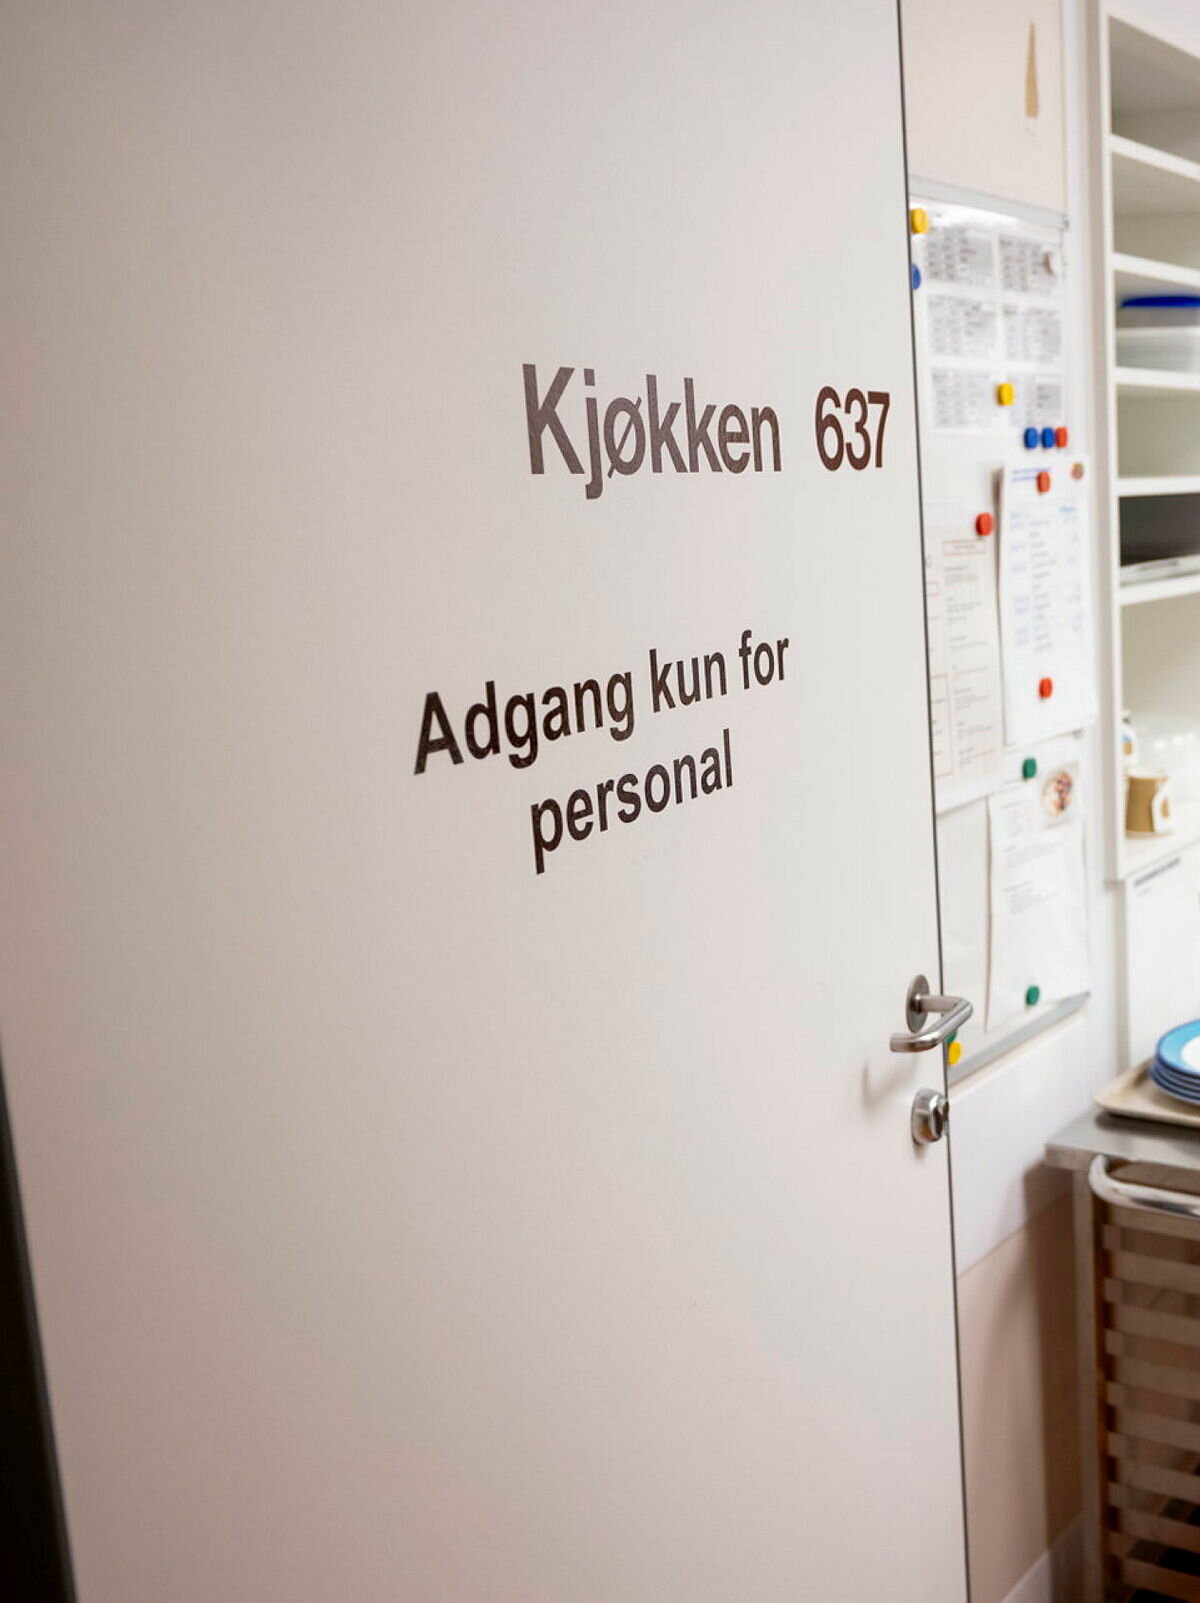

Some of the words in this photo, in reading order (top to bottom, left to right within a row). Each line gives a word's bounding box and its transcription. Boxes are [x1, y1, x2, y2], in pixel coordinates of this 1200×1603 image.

[522, 364, 782, 500] Kjøkken
[814, 385, 891, 472] 637
[413, 671, 635, 776] Adgang
[648, 648, 728, 714] kun
[738, 629, 790, 690] for
[530, 728, 734, 876] personal
